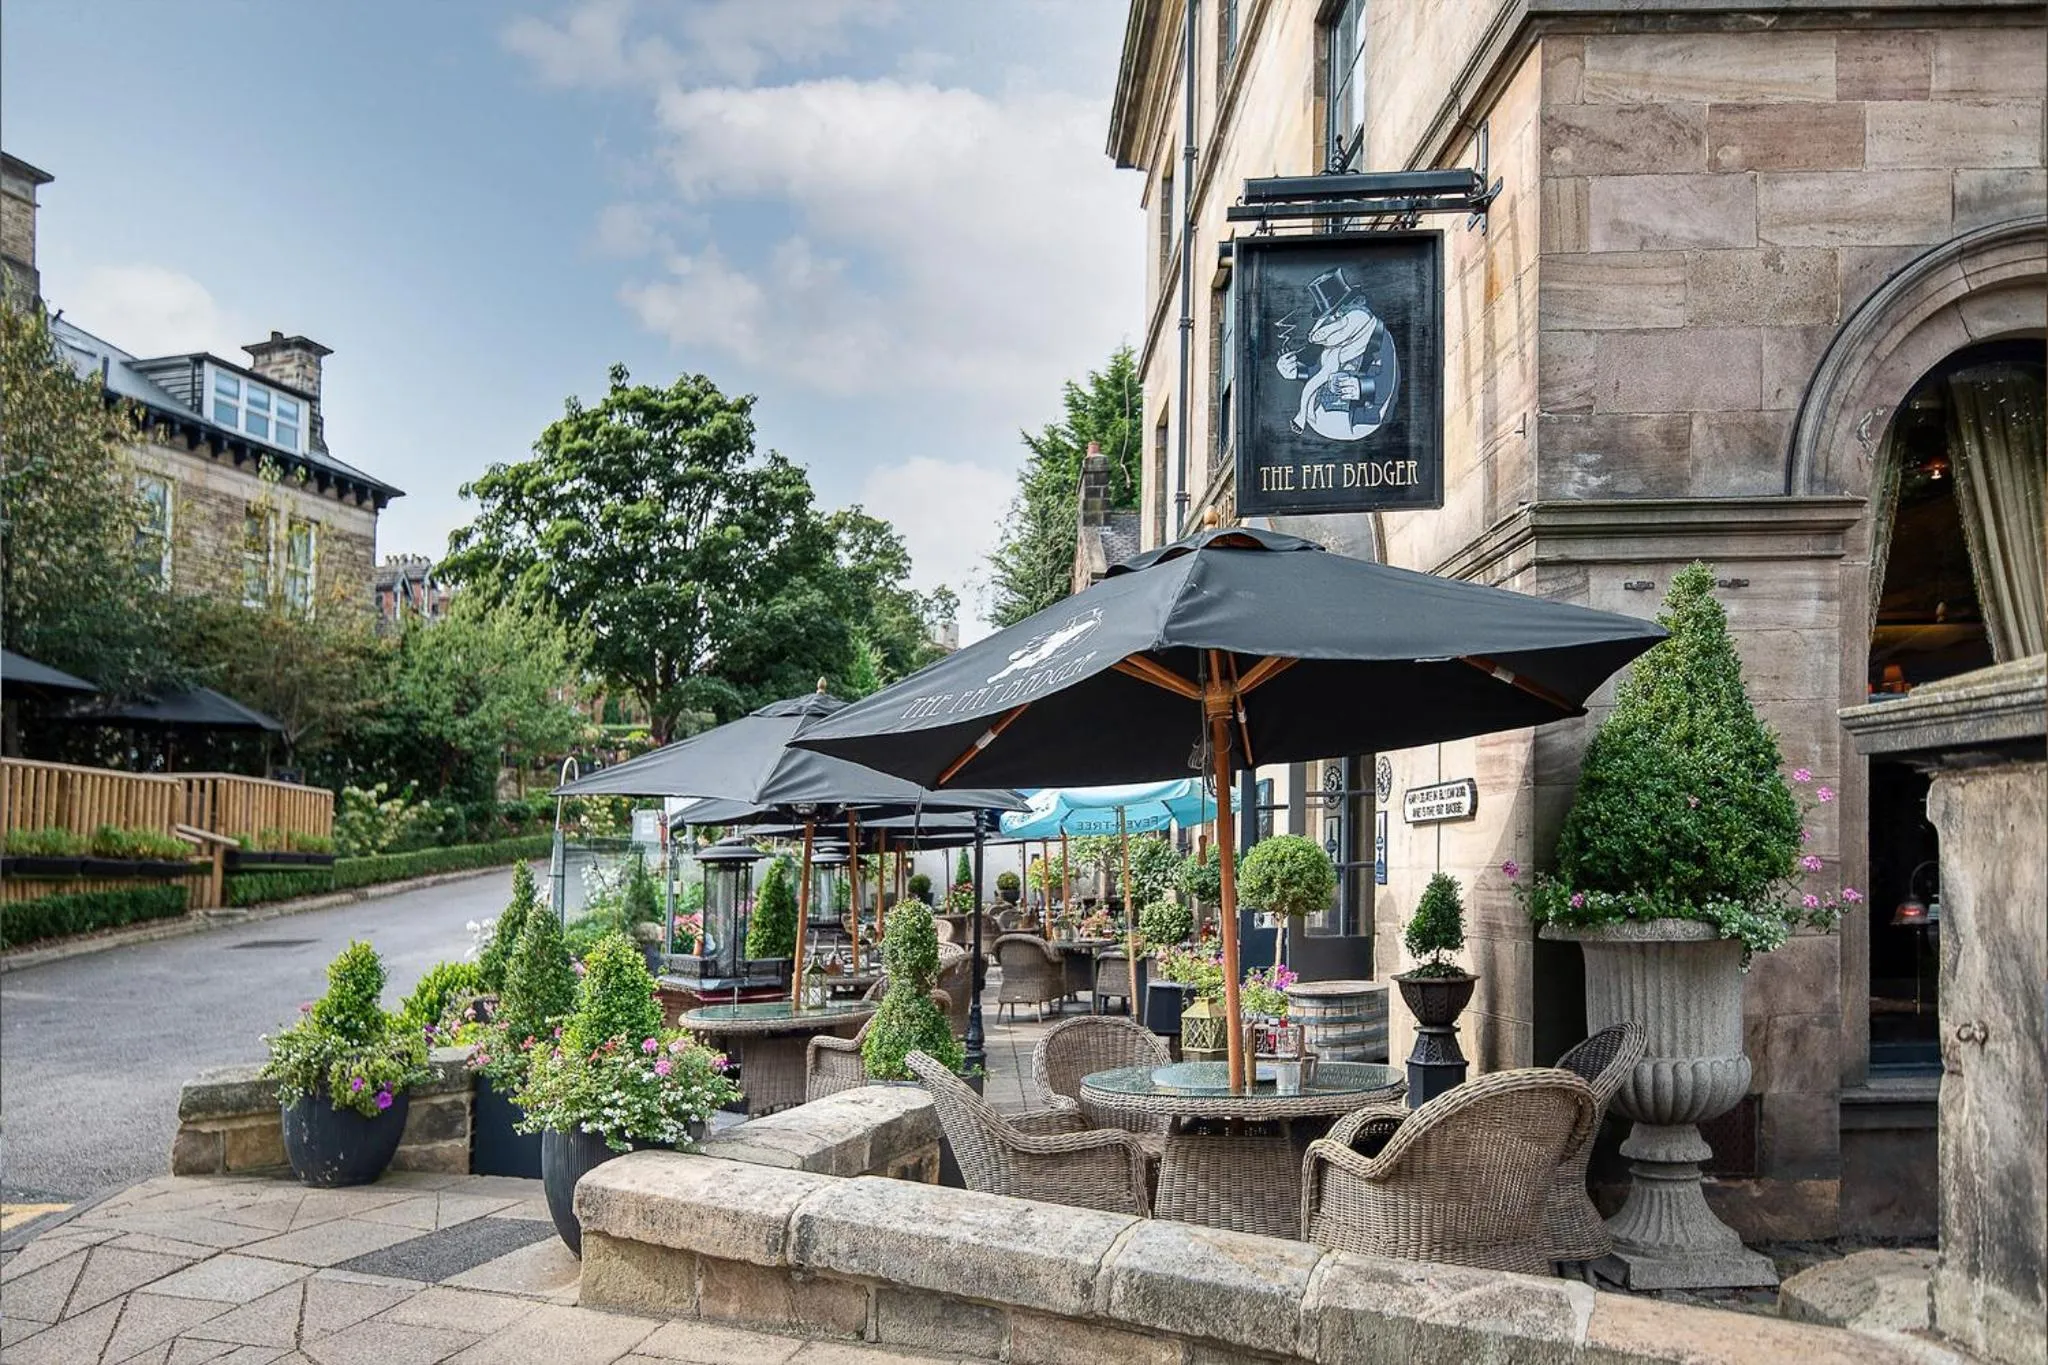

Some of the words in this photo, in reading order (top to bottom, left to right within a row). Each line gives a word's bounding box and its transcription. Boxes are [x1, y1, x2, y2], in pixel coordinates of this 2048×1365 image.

[1260, 465, 1295, 491] THE
[1302, 464, 1335, 490] FAT
[1343, 460, 1419, 488] BADGER
[900, 694, 954, 719] THE
[947, 684, 1004, 713] FAT
